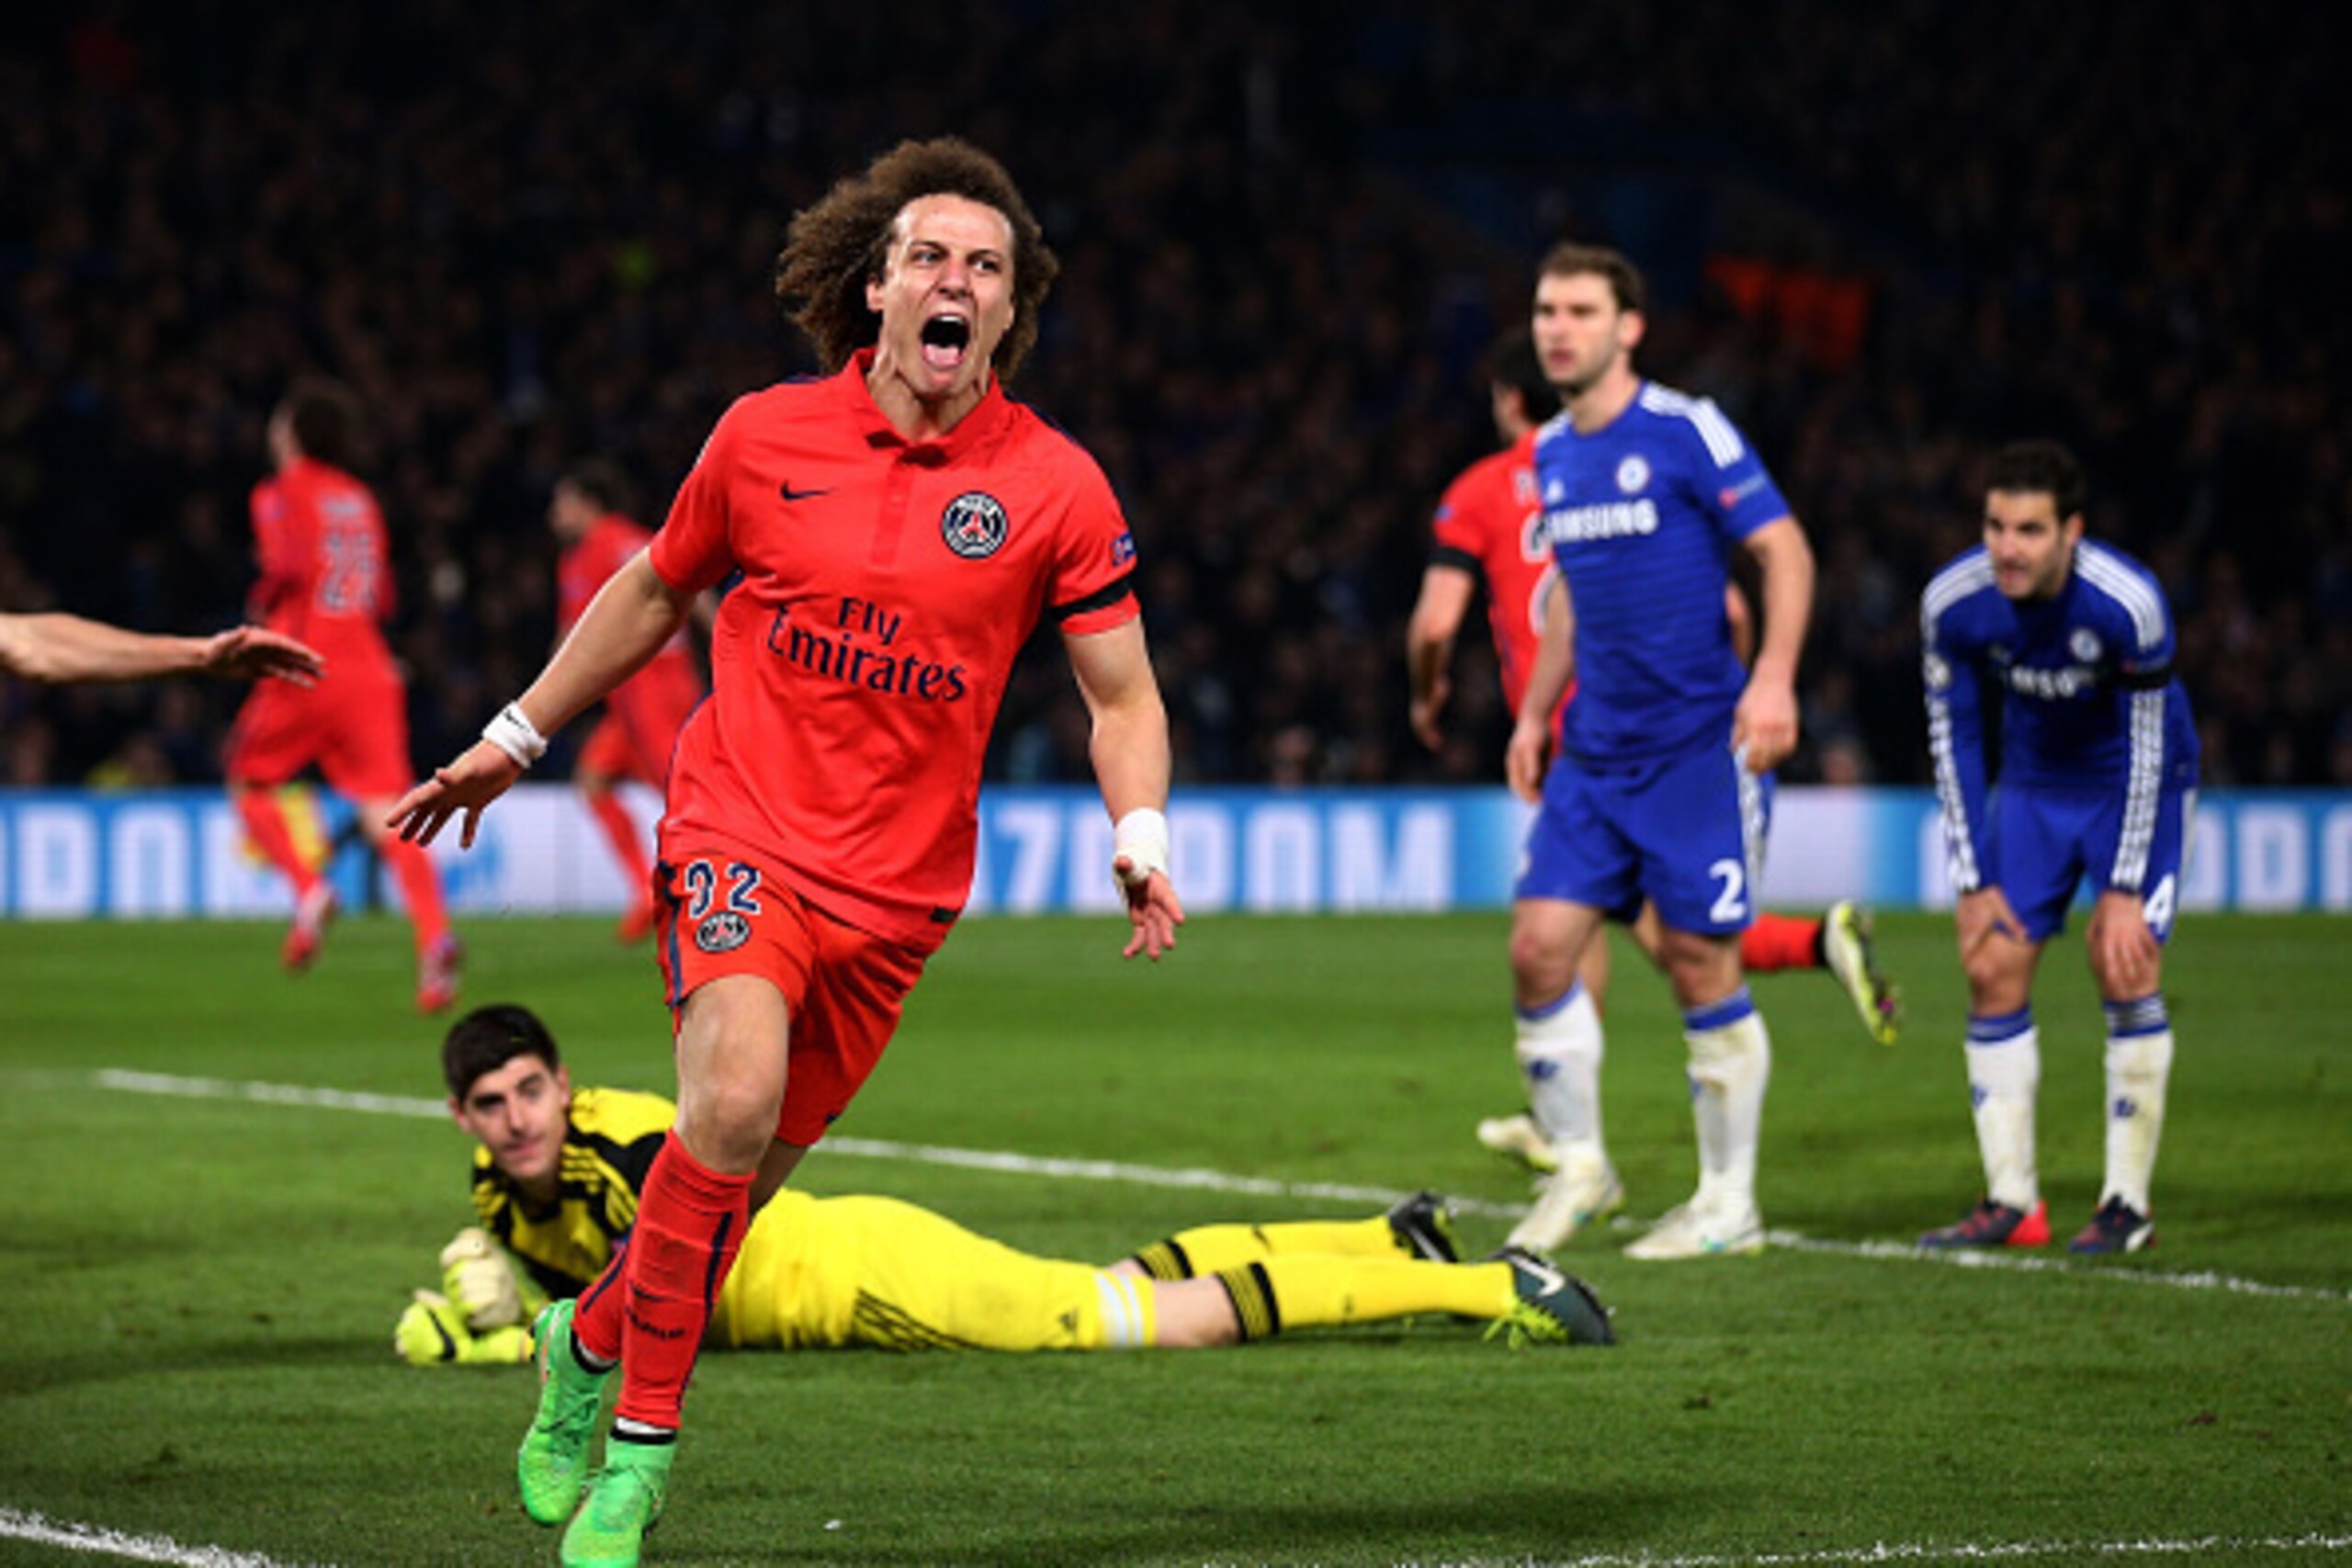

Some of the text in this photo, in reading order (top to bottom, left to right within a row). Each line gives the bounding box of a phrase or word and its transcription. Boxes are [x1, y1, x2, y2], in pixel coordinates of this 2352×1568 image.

[840, 597, 901, 645] Fly
[768, 604, 966, 701] Emirates
[1709, 860, 1745, 921] 2
[2143, 874, 2176, 932] 4
